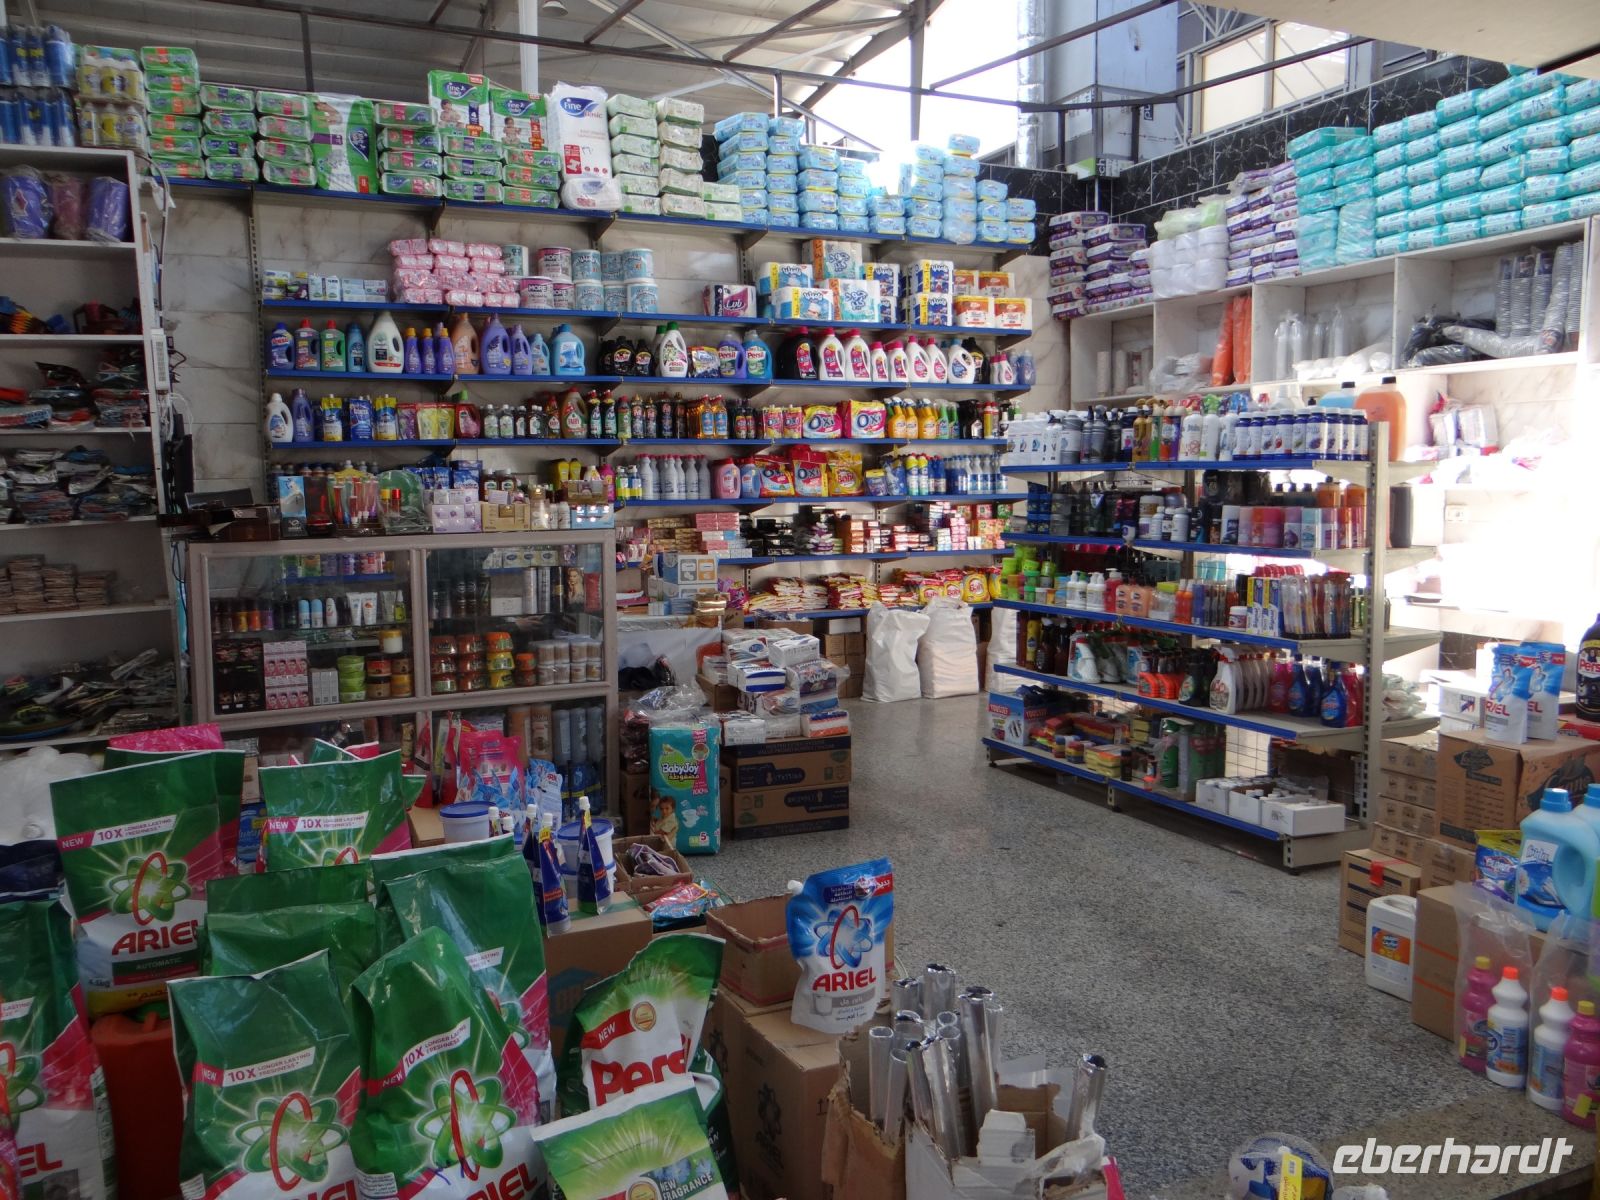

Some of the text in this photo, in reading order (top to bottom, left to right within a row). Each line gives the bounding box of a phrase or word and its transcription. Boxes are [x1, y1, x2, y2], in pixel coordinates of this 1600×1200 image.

[269, 821, 289, 831] NEW
[62, 837, 84, 849] NEW
[812, 966, 877, 993] ARIEL
[598, 1021, 617, 1042] NEW
[257, 1060, 283, 1072] LONGER
[283, 1051, 311, 1065] LASTING
[201, 1067, 218, 1082] NEW
[383, 1071, 404, 1088] NEW
[660, 1178, 678, 1192] NEW
[662, 1172, 714, 1200] FRAGRANCE
